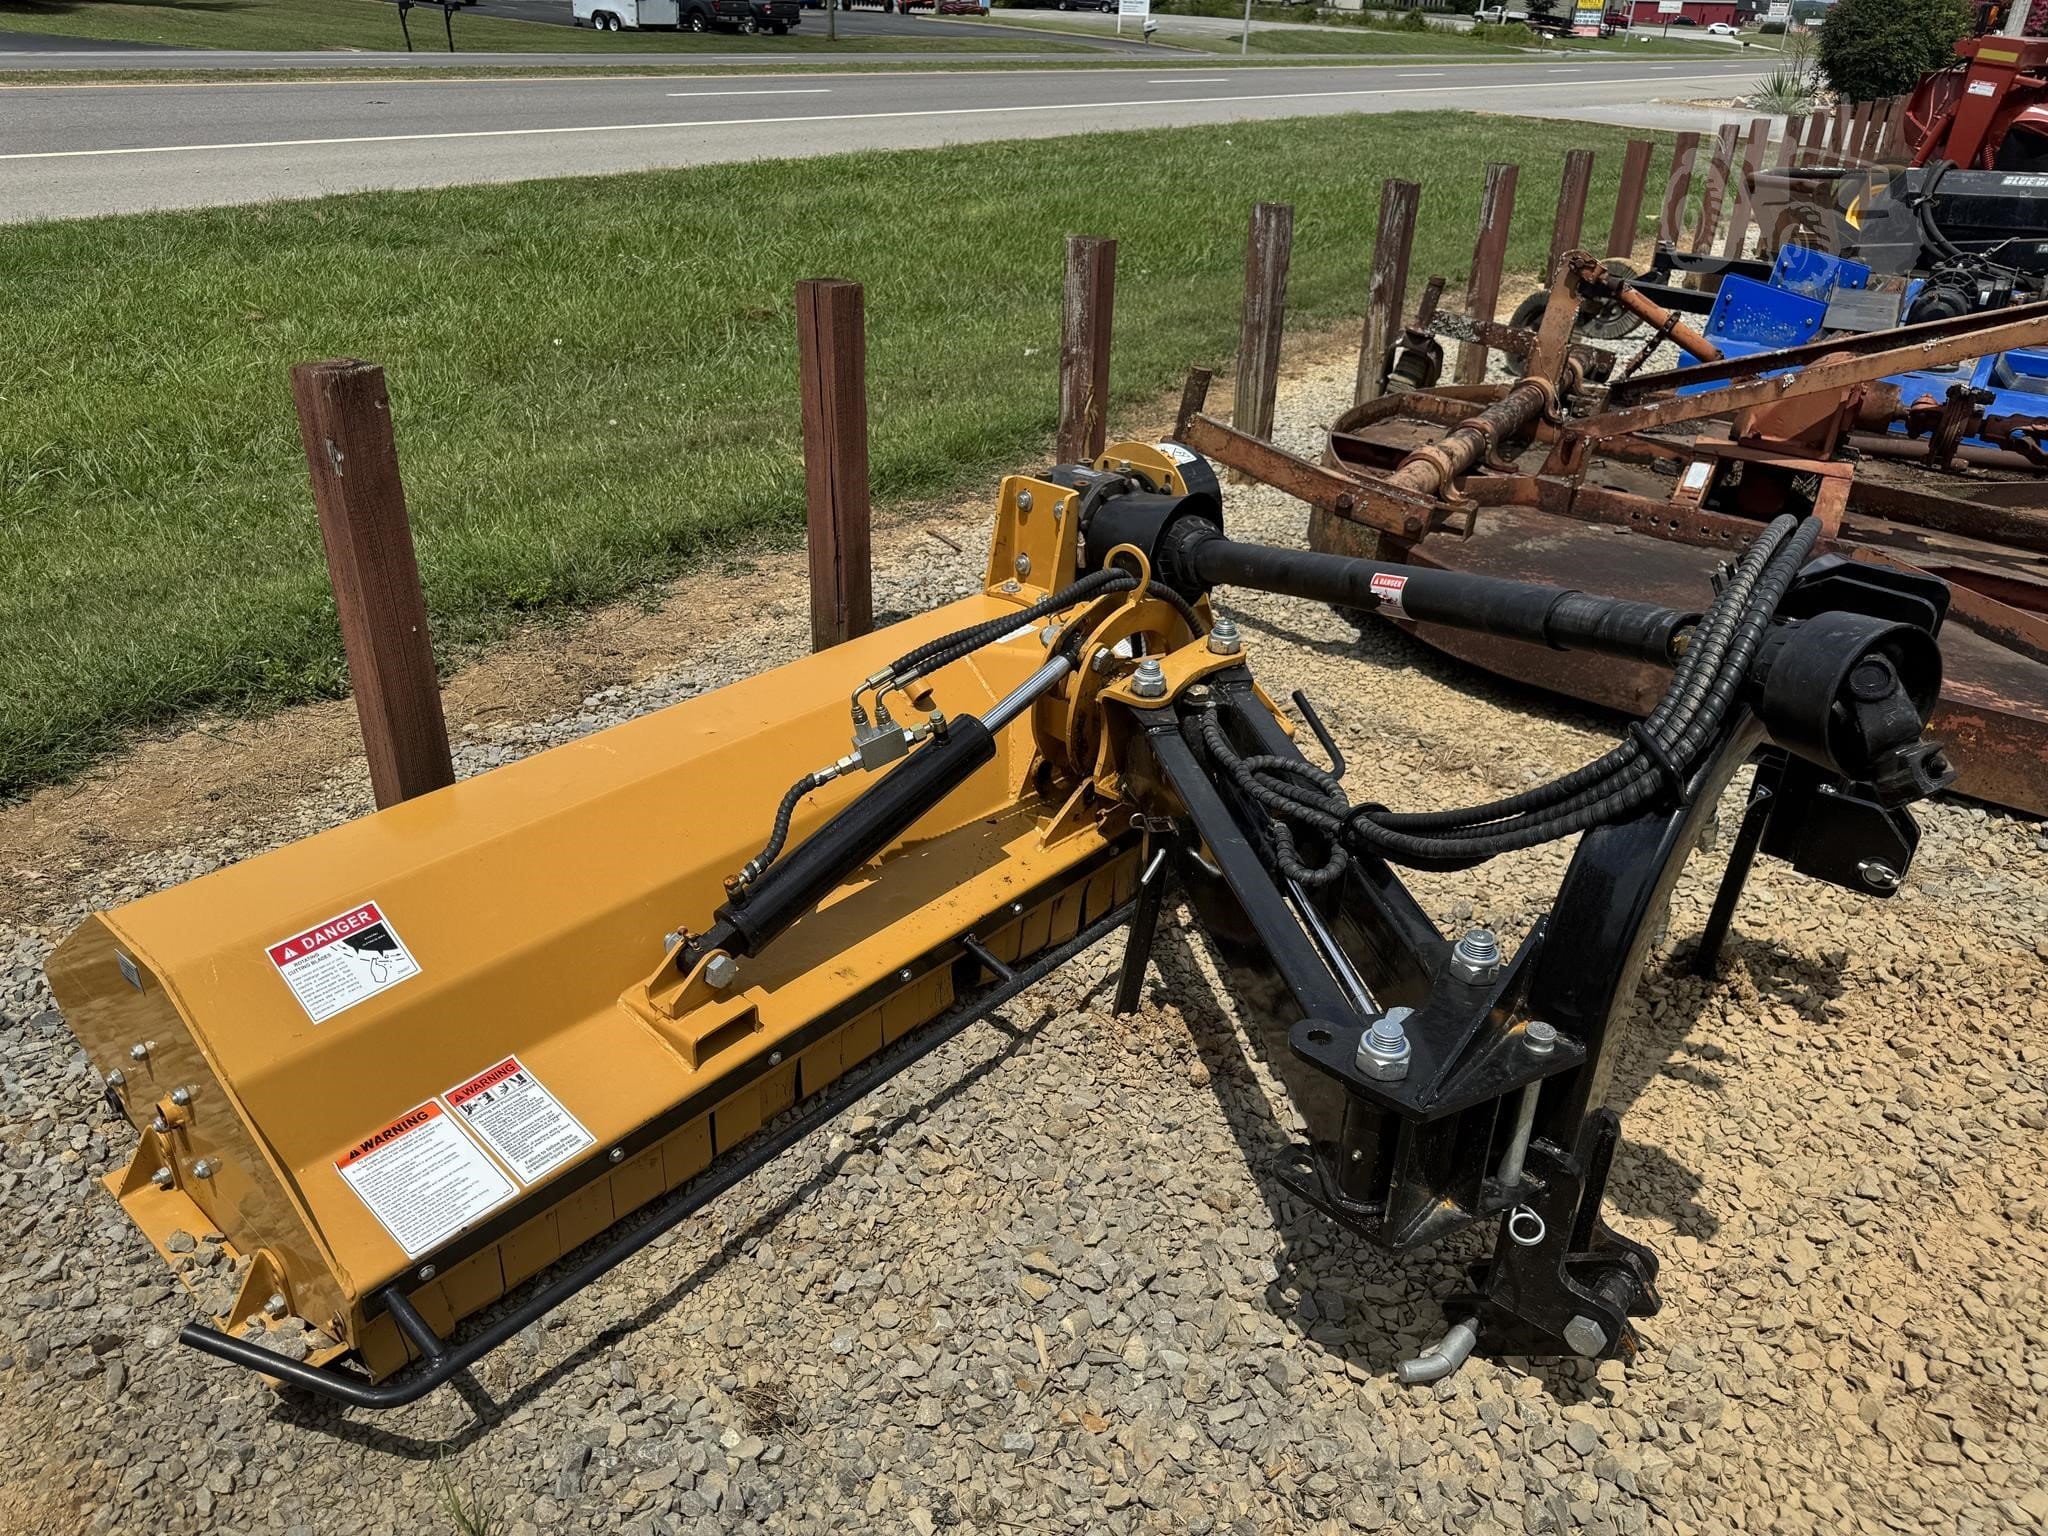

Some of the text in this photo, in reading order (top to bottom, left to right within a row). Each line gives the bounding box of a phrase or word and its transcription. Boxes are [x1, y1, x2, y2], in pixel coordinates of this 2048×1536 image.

[1379, 577, 1402, 587] DANGER
[301, 910, 372, 950] DANGER
[288, 953, 332, 976] CUTTING BLADES
[294, 952, 320, 967] ROTATING
[462, 1063, 516, 1096] WARNING
[360, 1111, 429, 1152] WARNING
